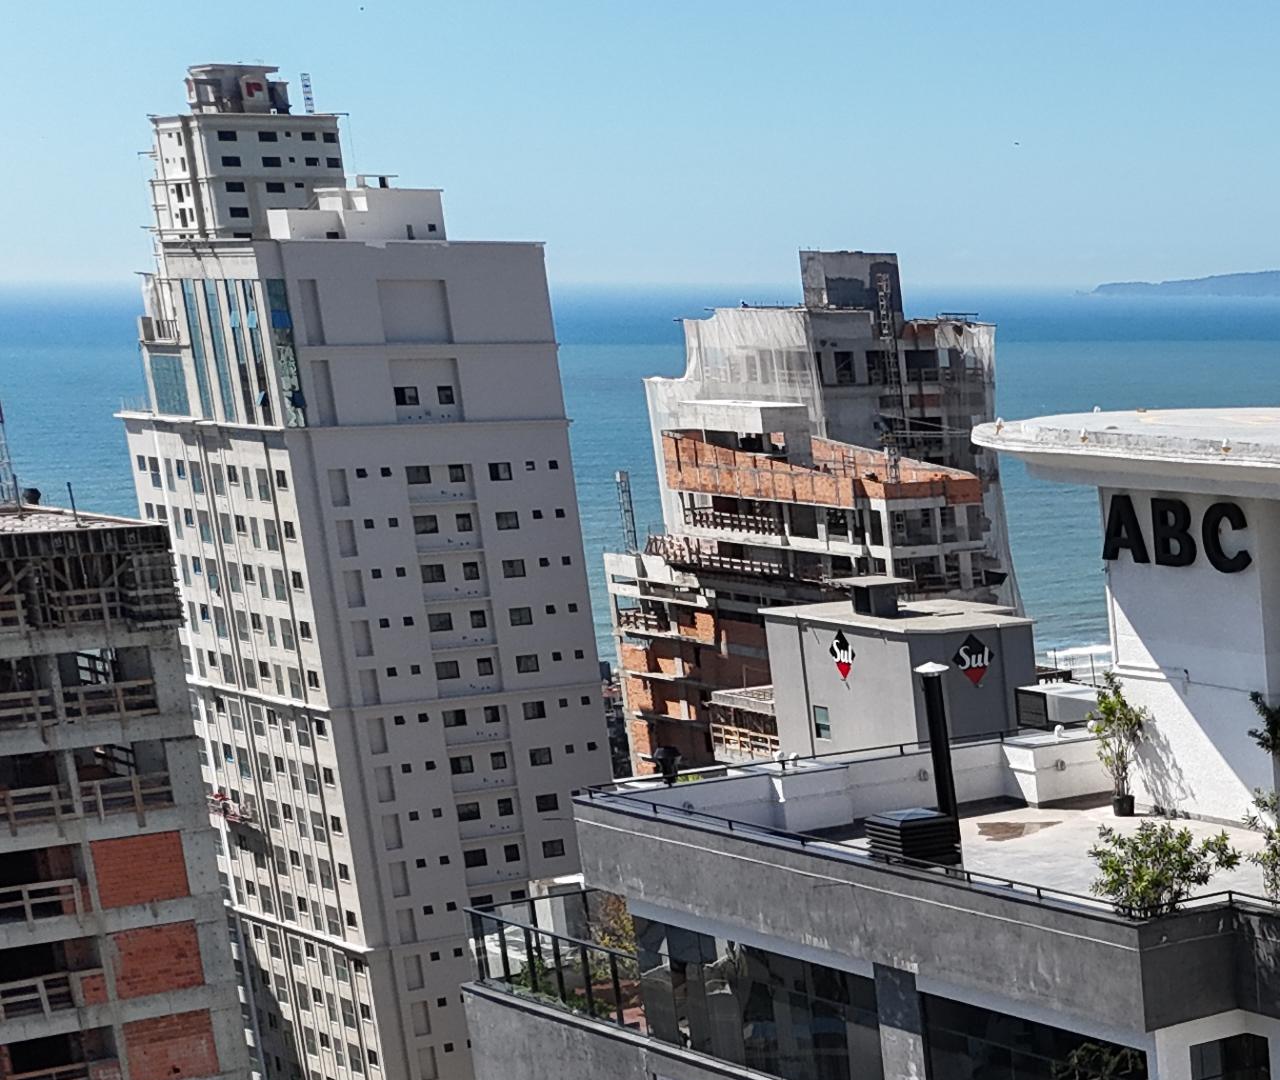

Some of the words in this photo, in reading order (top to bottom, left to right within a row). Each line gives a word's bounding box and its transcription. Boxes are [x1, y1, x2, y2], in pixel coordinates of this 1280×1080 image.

[1102, 494, 1253, 574] ABC
[832, 639, 853, 664] Sul
[957, 645, 990, 670] Sul
